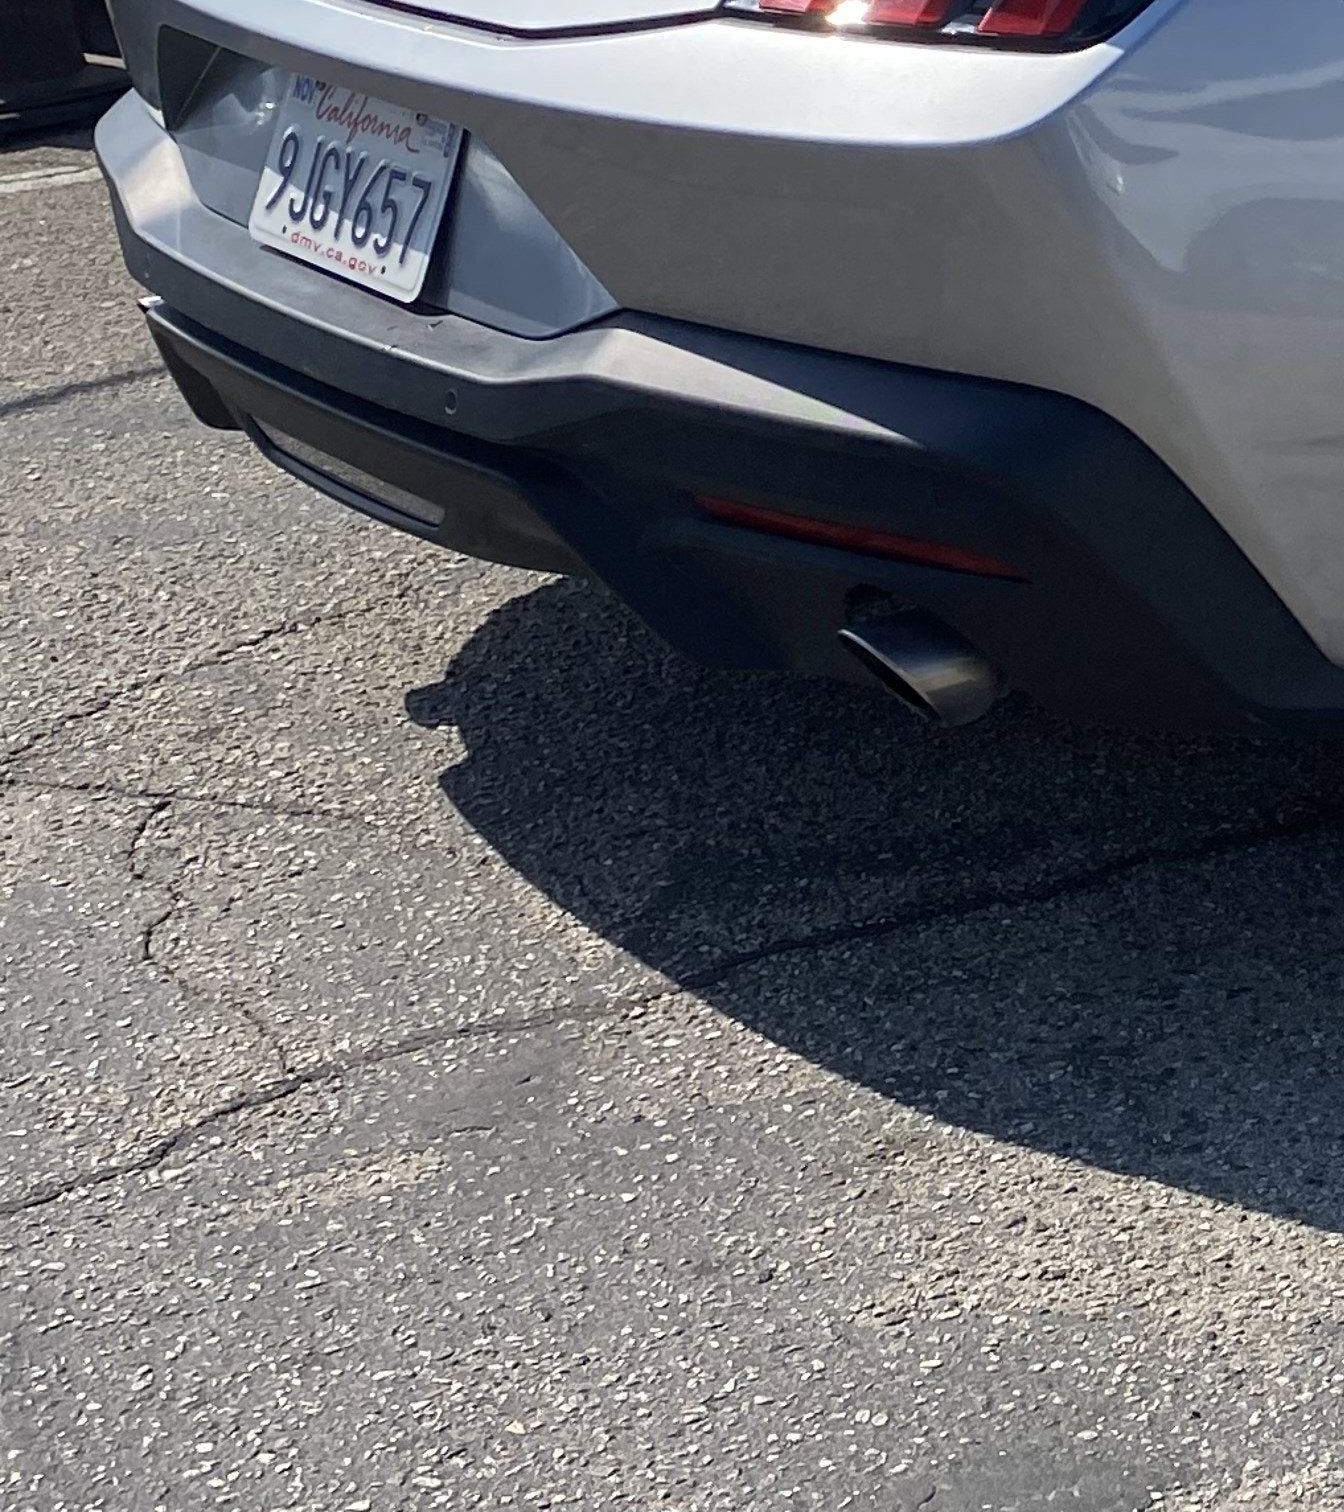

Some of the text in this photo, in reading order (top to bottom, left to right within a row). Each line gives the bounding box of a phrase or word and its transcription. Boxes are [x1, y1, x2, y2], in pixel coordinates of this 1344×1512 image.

[315, 84, 420, 154] California
[264, 130, 432, 265] 9JGY657
[290, 230, 378, 276] dmv.ca.gov
